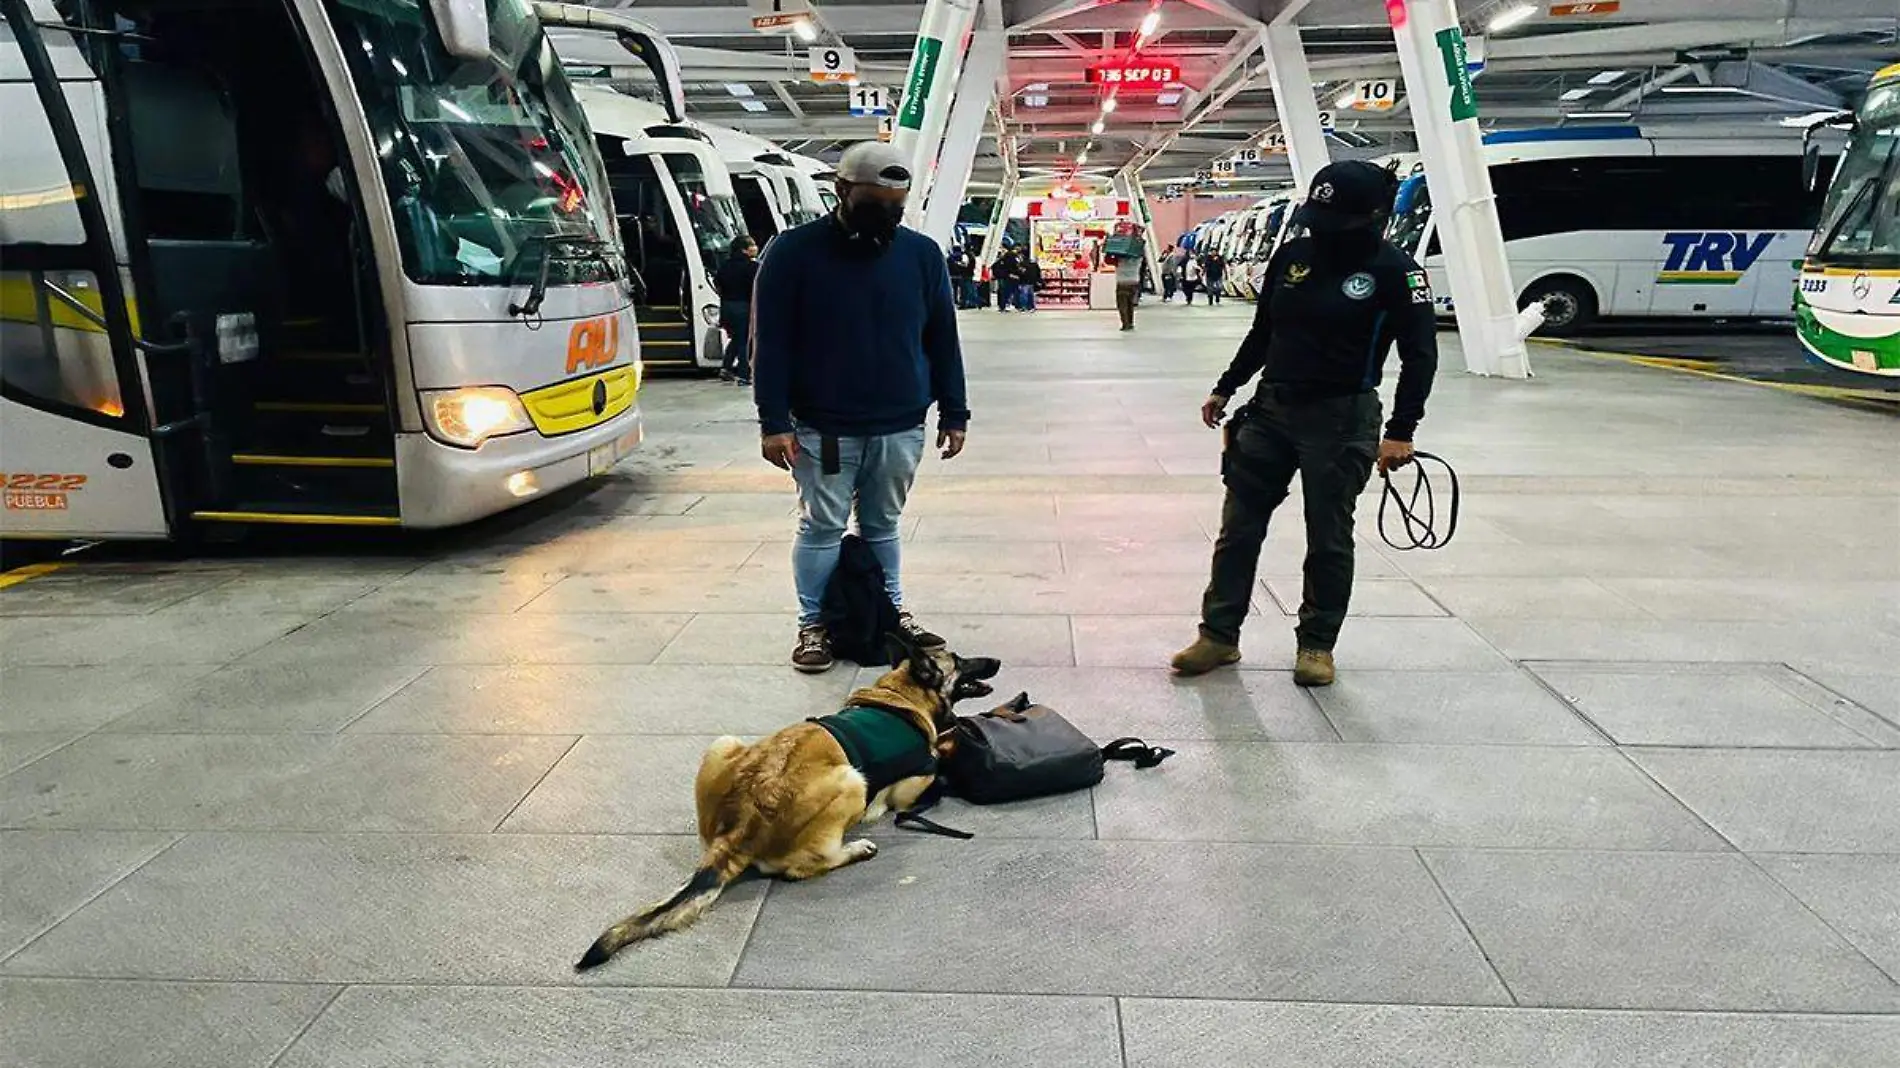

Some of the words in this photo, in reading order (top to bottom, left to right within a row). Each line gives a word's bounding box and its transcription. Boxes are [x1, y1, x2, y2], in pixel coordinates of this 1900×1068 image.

[824, 50, 840, 70] 9
[1124, 68, 1150, 82] SEP
[1152, 68, 1172, 82] 03
[857, 90, 880, 106] 11
[1362, 82, 1388, 99] 10
[1318, 112, 1330, 126] 2
[1240, 149, 1256, 160] 16
[1218, 161, 1231, 171] 18
[1662, 232, 1776, 271] TRV
[566, 316, 618, 374] AU
[6, 494, 66, 509] PUEBLA
